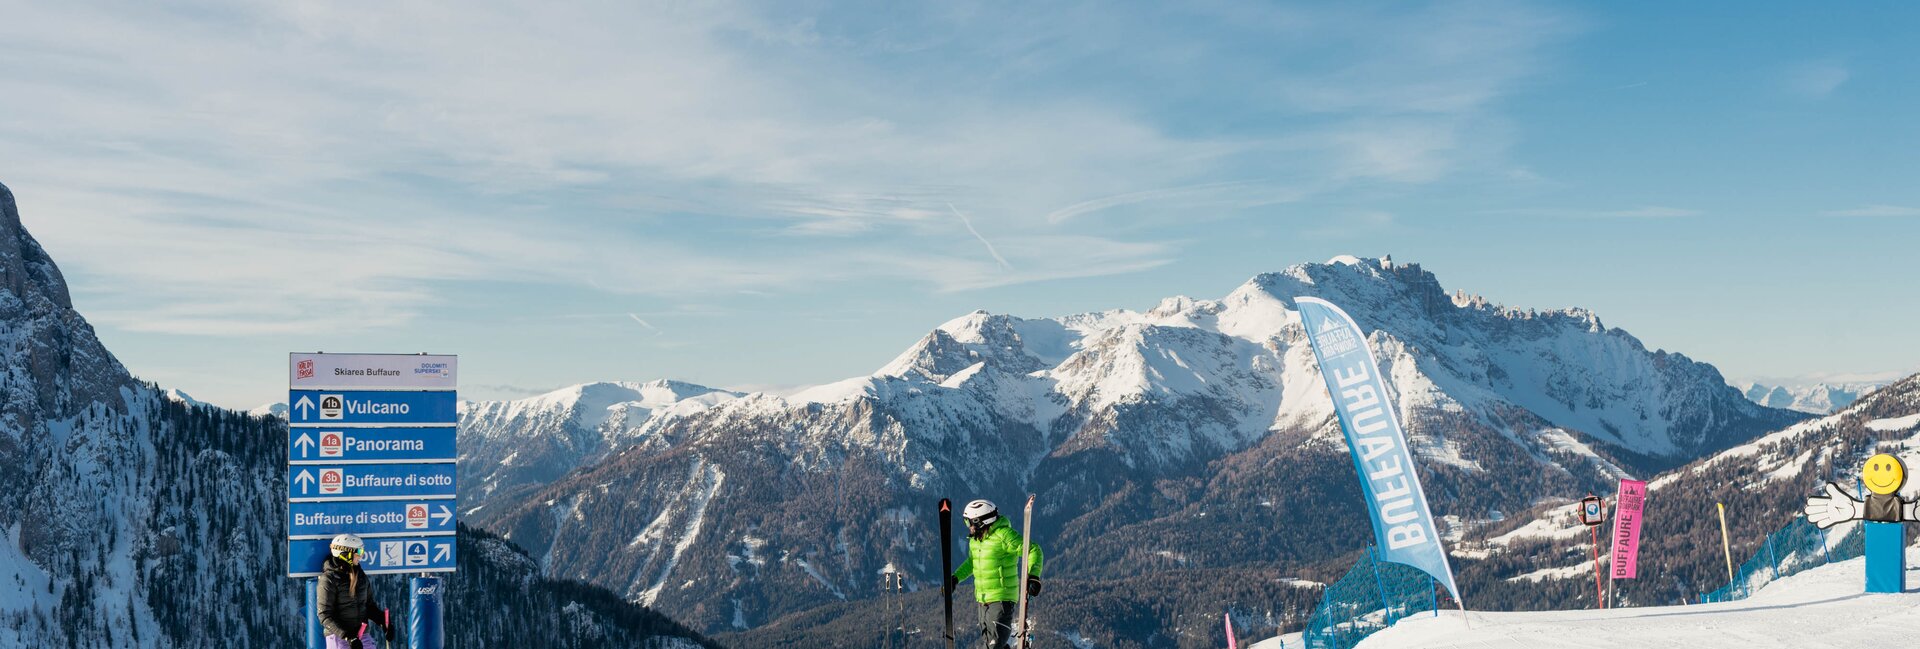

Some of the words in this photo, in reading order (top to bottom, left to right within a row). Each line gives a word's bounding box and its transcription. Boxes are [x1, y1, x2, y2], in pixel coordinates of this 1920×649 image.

[334, 367, 365, 376] Skiarea
[366, 368, 401, 376] Buffaure
[326, 399, 338, 408] 1b
[346, 400, 410, 415] Vulcano
[326, 436, 338, 446] 1a
[345, 437, 424, 451] Panorama
[325, 473, 338, 483] 3b
[346, 474, 402, 487] Buffaure
[405, 474, 417, 486] di
[419, 474, 452, 486] sotto
[412, 508, 423, 517] 3a
[295, 513, 352, 525] Buffaure
[356, 512, 368, 524] di
[370, 511, 404, 523] sotto
[414, 545, 420, 554] 4
[1616, 515, 1632, 576] BUFFAURE
